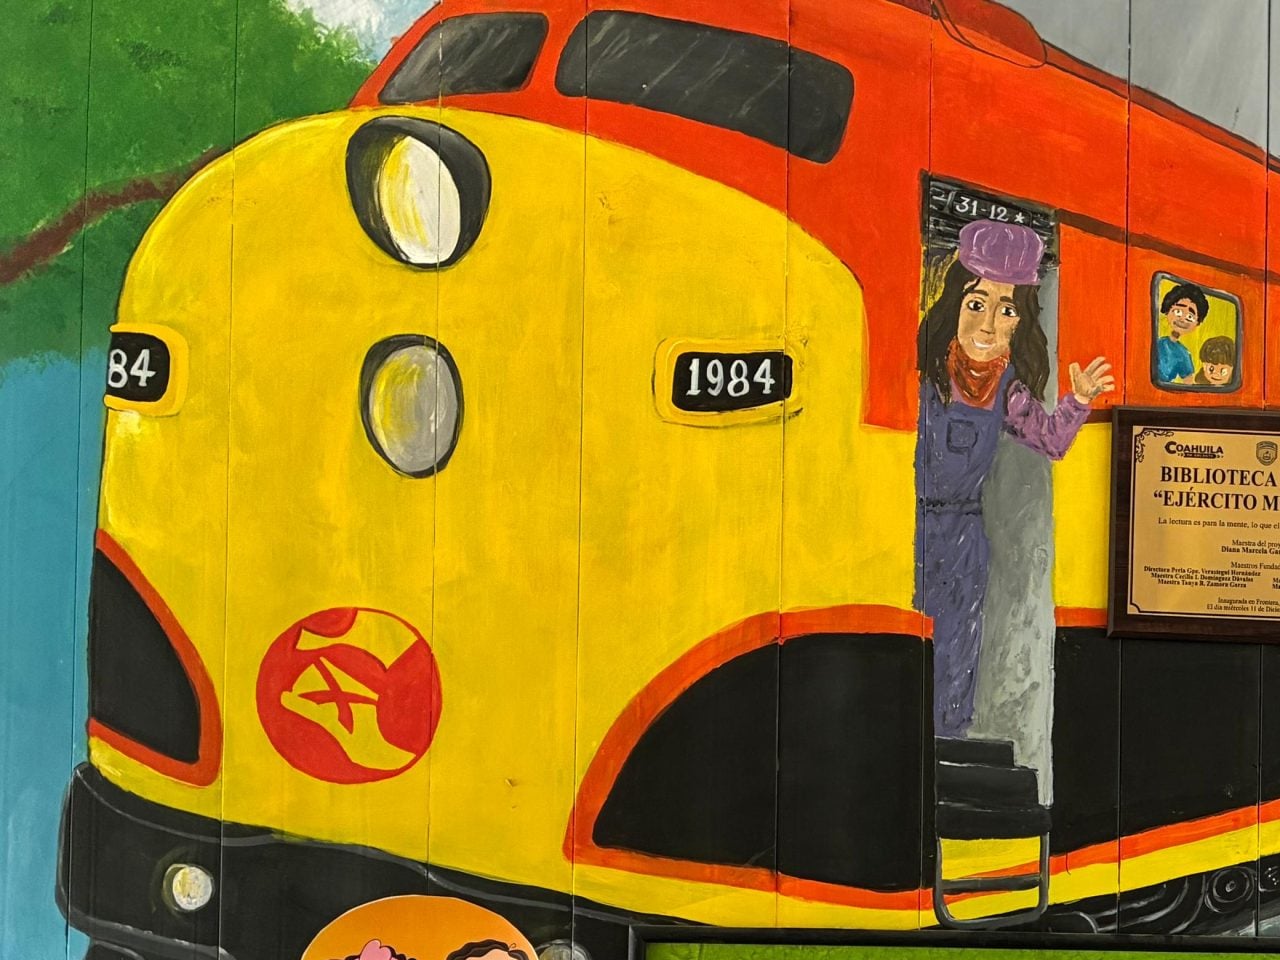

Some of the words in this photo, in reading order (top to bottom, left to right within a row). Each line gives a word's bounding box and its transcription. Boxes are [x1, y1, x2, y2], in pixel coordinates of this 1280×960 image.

[686, 358, 776, 397] 1984
[1164, 440, 1224, 454] COAHUILA
[1160, 466, 1277, 487] BIBLIOTECA
[1158, 517, 1167, 525] La
[1169, 517, 1192, 526] lectura
[1202, 520, 1217, 528] para
[1219, 519, 1225, 527] la
[1260, 522, 1272, 530] que
[1232, 539, 1256, 547] Maestra
[1241, 546, 1268, 554] Marcela
[1143, 565, 1170, 573] Directora
[1231, 561, 1258, 569] Maestros
[1158, 578, 1180, 586] Maestra
